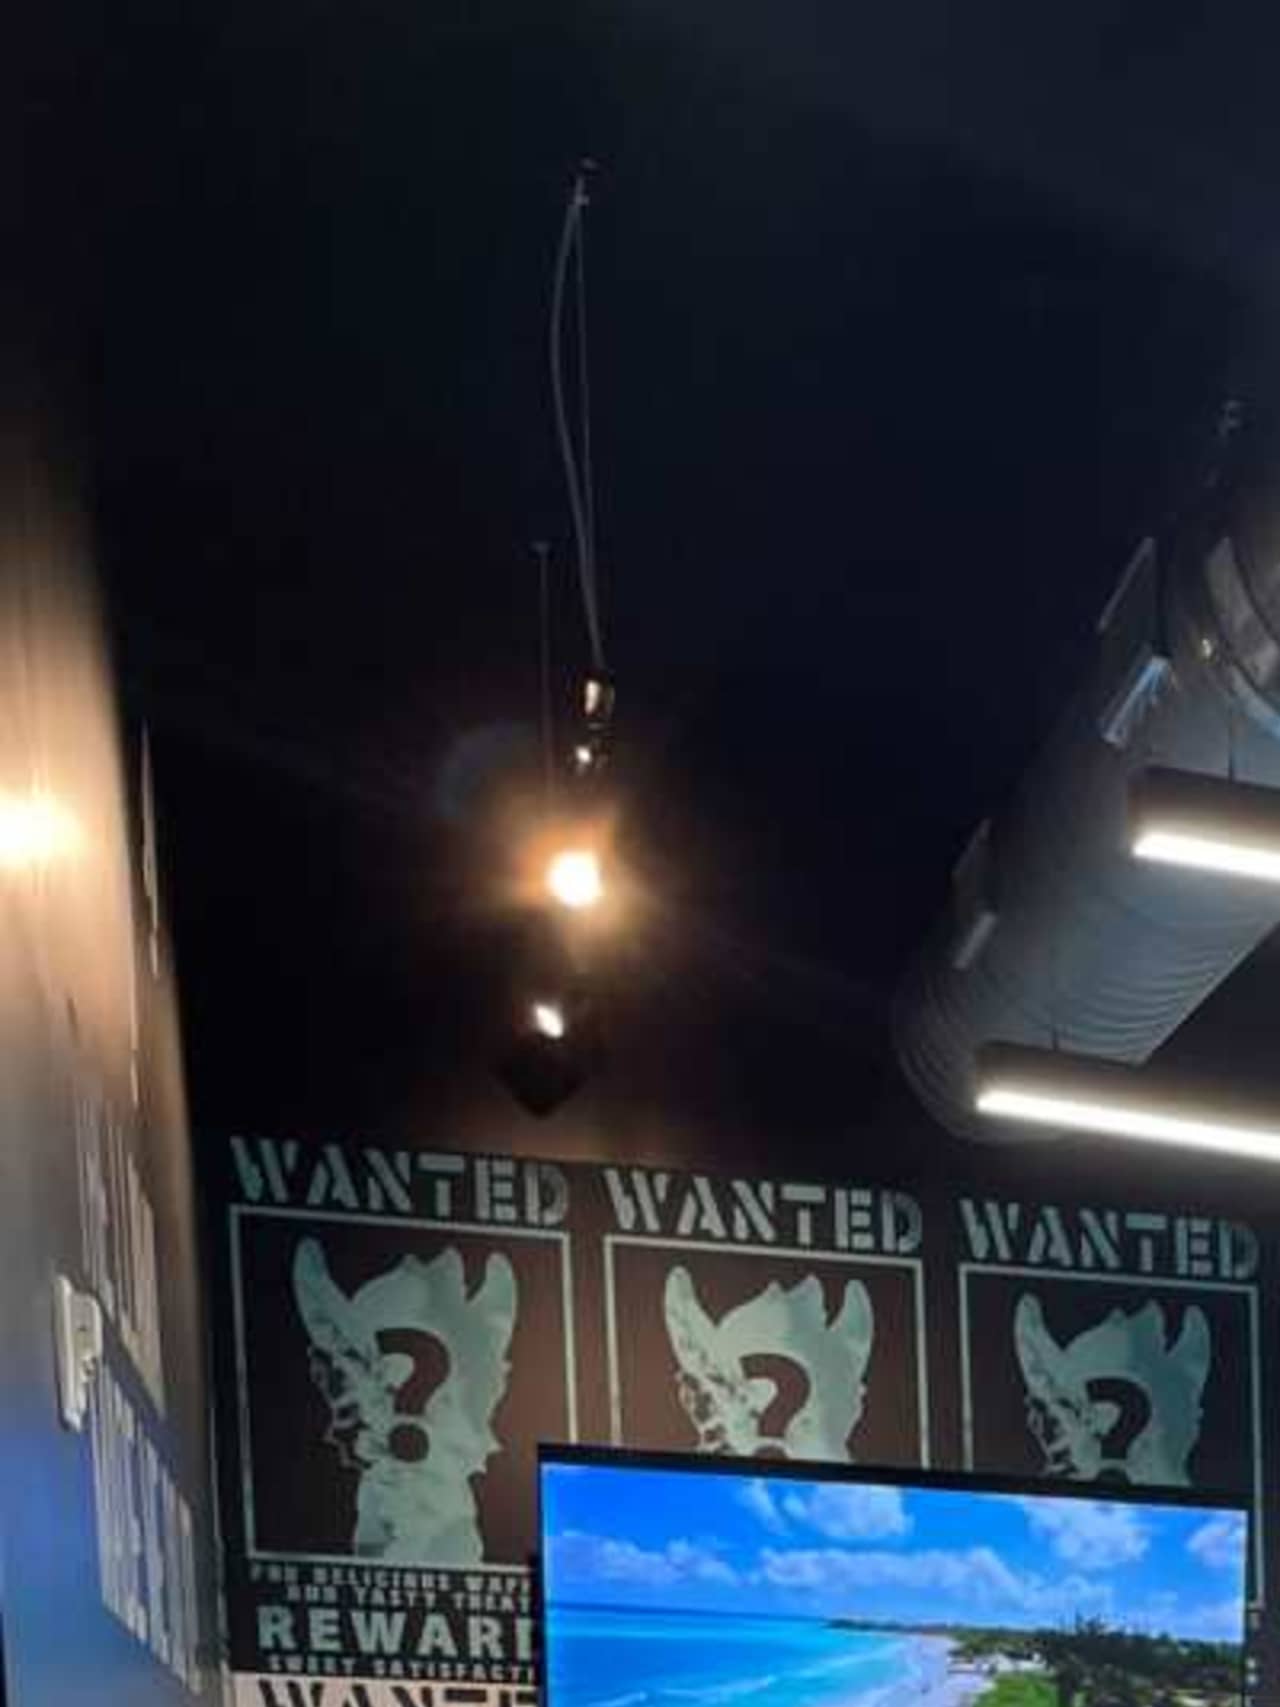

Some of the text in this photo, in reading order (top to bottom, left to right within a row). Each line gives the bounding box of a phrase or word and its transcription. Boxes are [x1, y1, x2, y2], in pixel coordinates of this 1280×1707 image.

[230, 1137, 568, 1225] WANTED
[604, 1168, 922, 1252] WANTED
[960, 1199, 1258, 1280] WANTED
